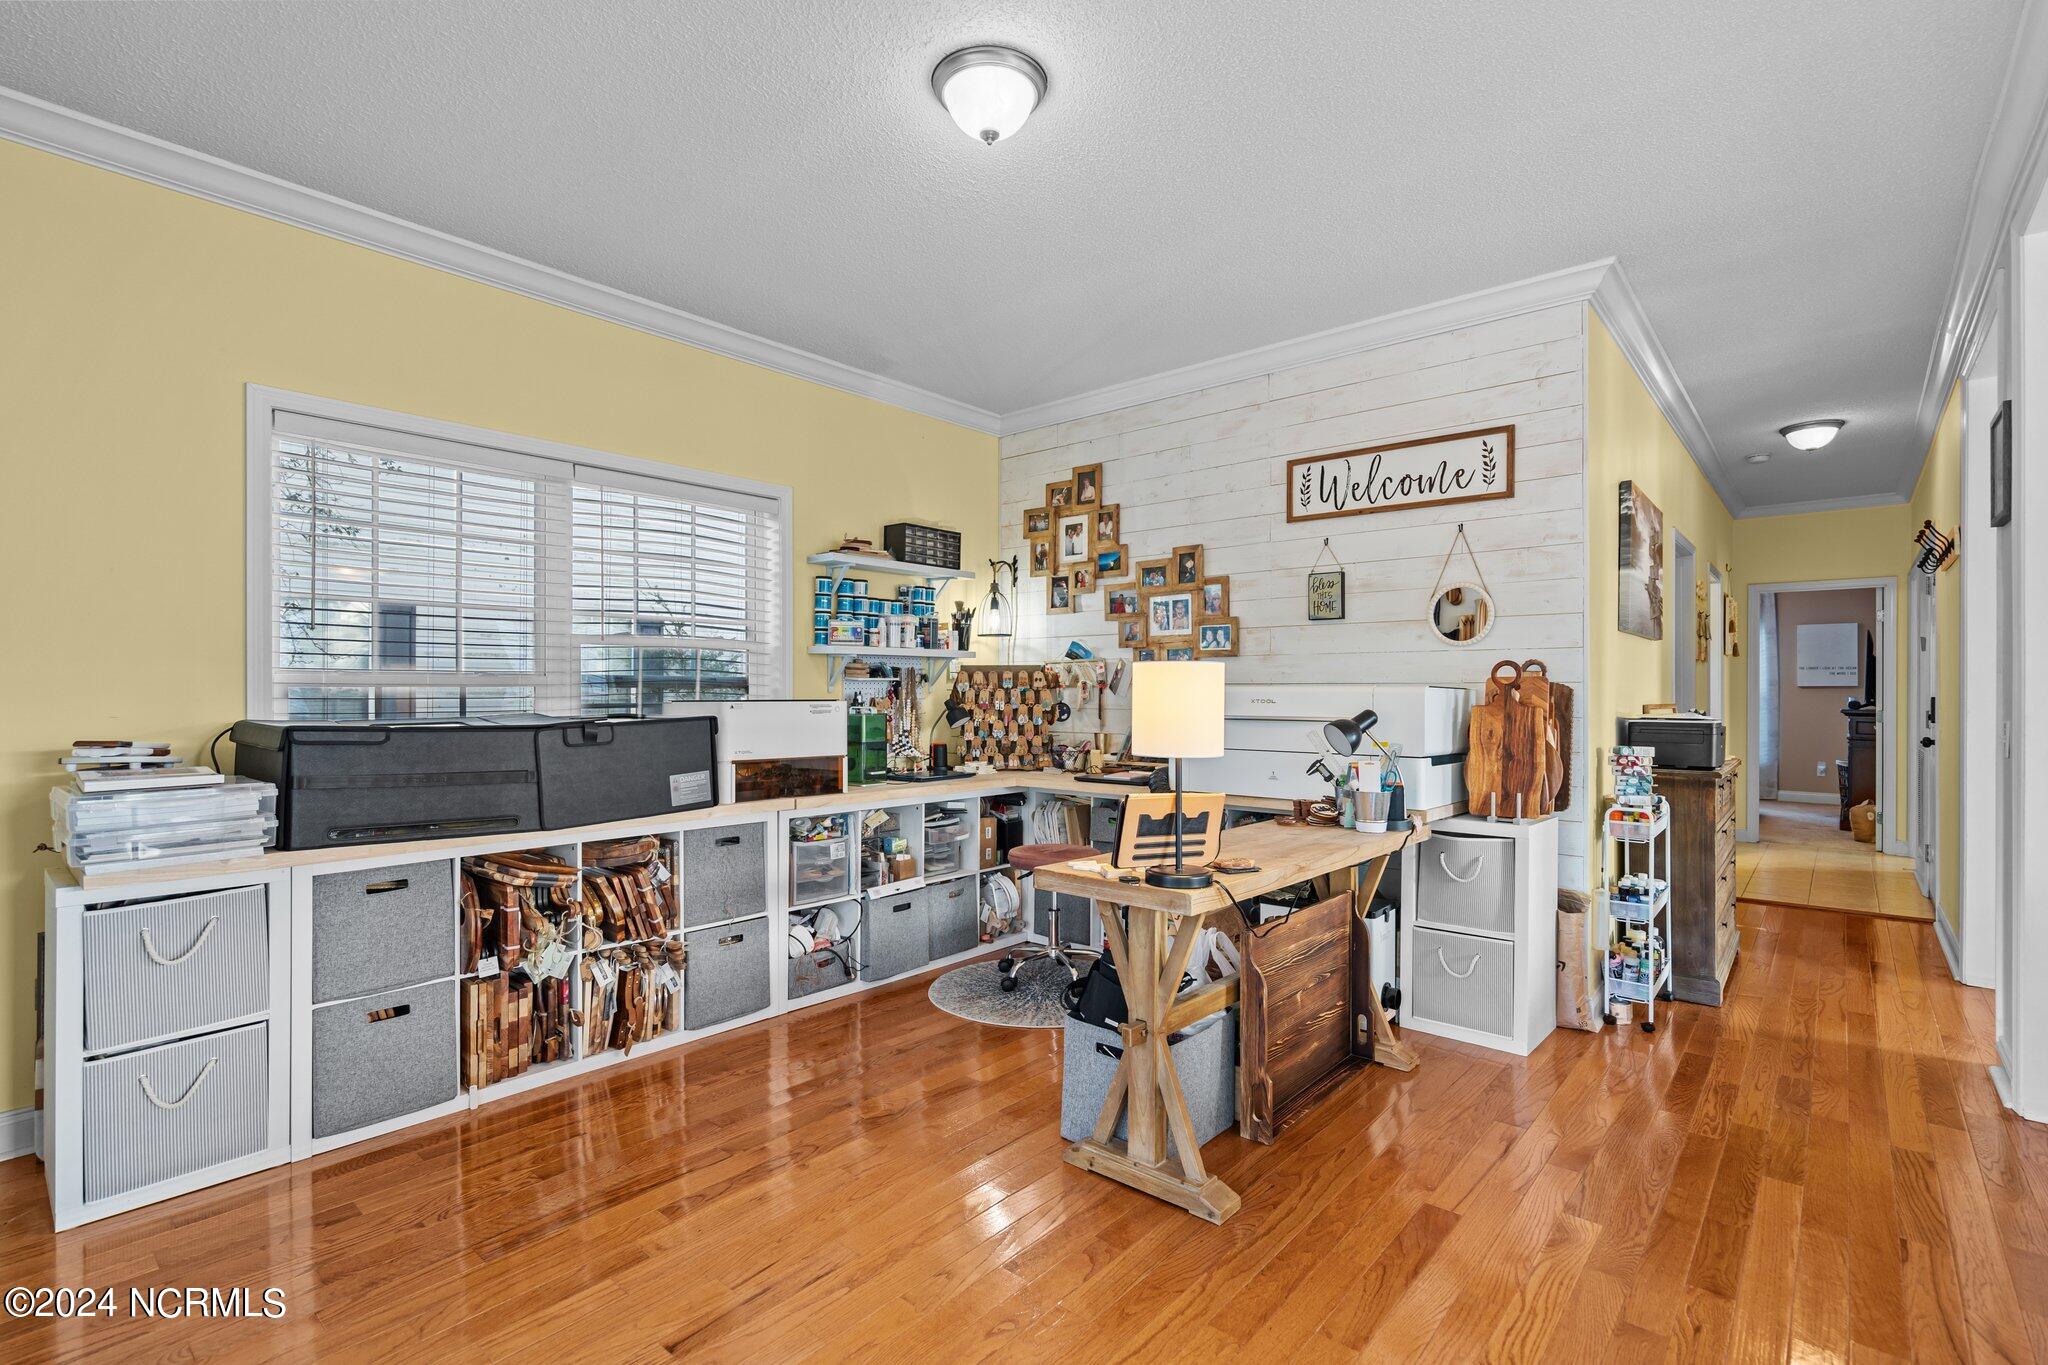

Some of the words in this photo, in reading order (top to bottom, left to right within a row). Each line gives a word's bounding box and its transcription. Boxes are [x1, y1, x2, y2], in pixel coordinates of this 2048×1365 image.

[1319, 454, 1476, 511] Welcome
[1316, 591, 1333, 600] THIS
[1313, 600, 1337, 616] HOME
[680, 773, 706, 783] DANGER
